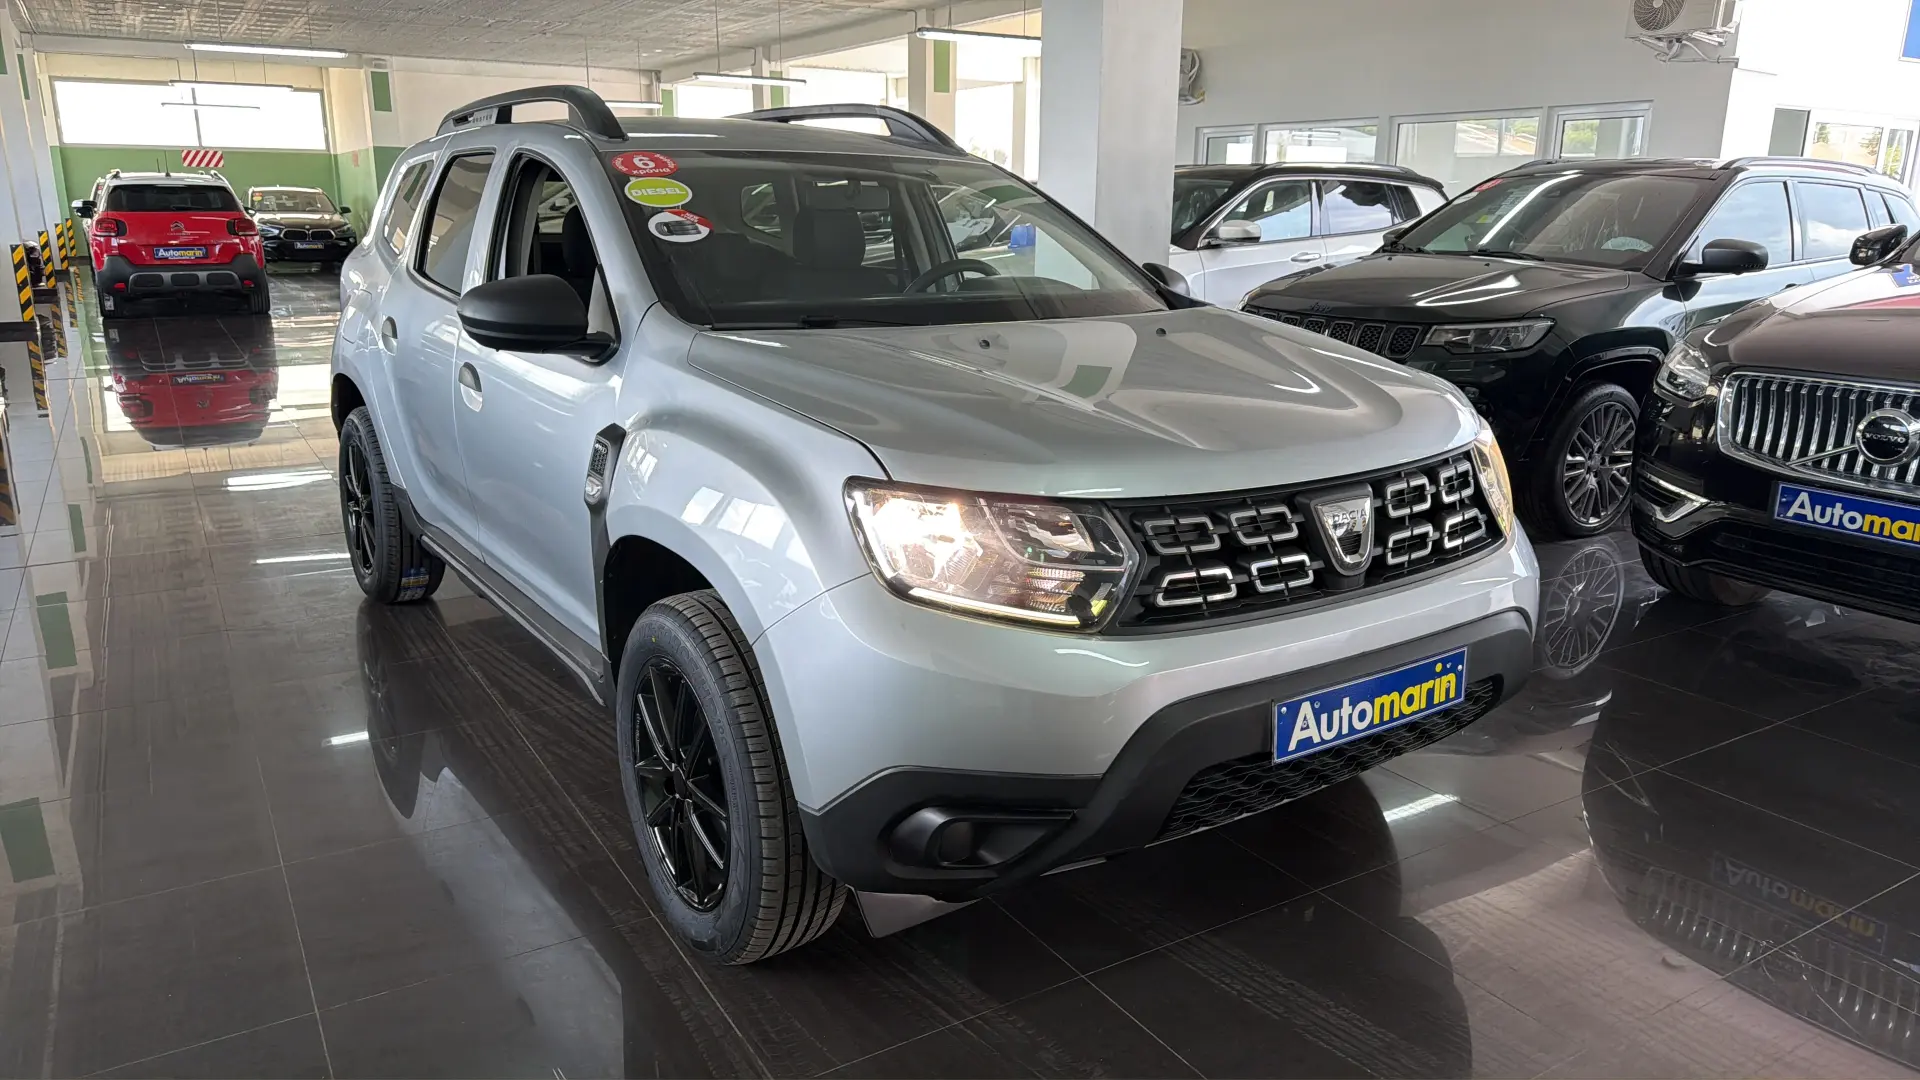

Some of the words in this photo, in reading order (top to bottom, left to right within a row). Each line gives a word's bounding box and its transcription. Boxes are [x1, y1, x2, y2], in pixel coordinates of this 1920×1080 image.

[632, 156, 656, 169] 6
[630, 187, 687, 197] DIESEL
[158, 247, 204, 257] Automarin
[1865, 432, 1906, 443] VOLVO
[1332, 508, 1366, 521] DACIA
[1287, 662, 1457, 752] Automarin
